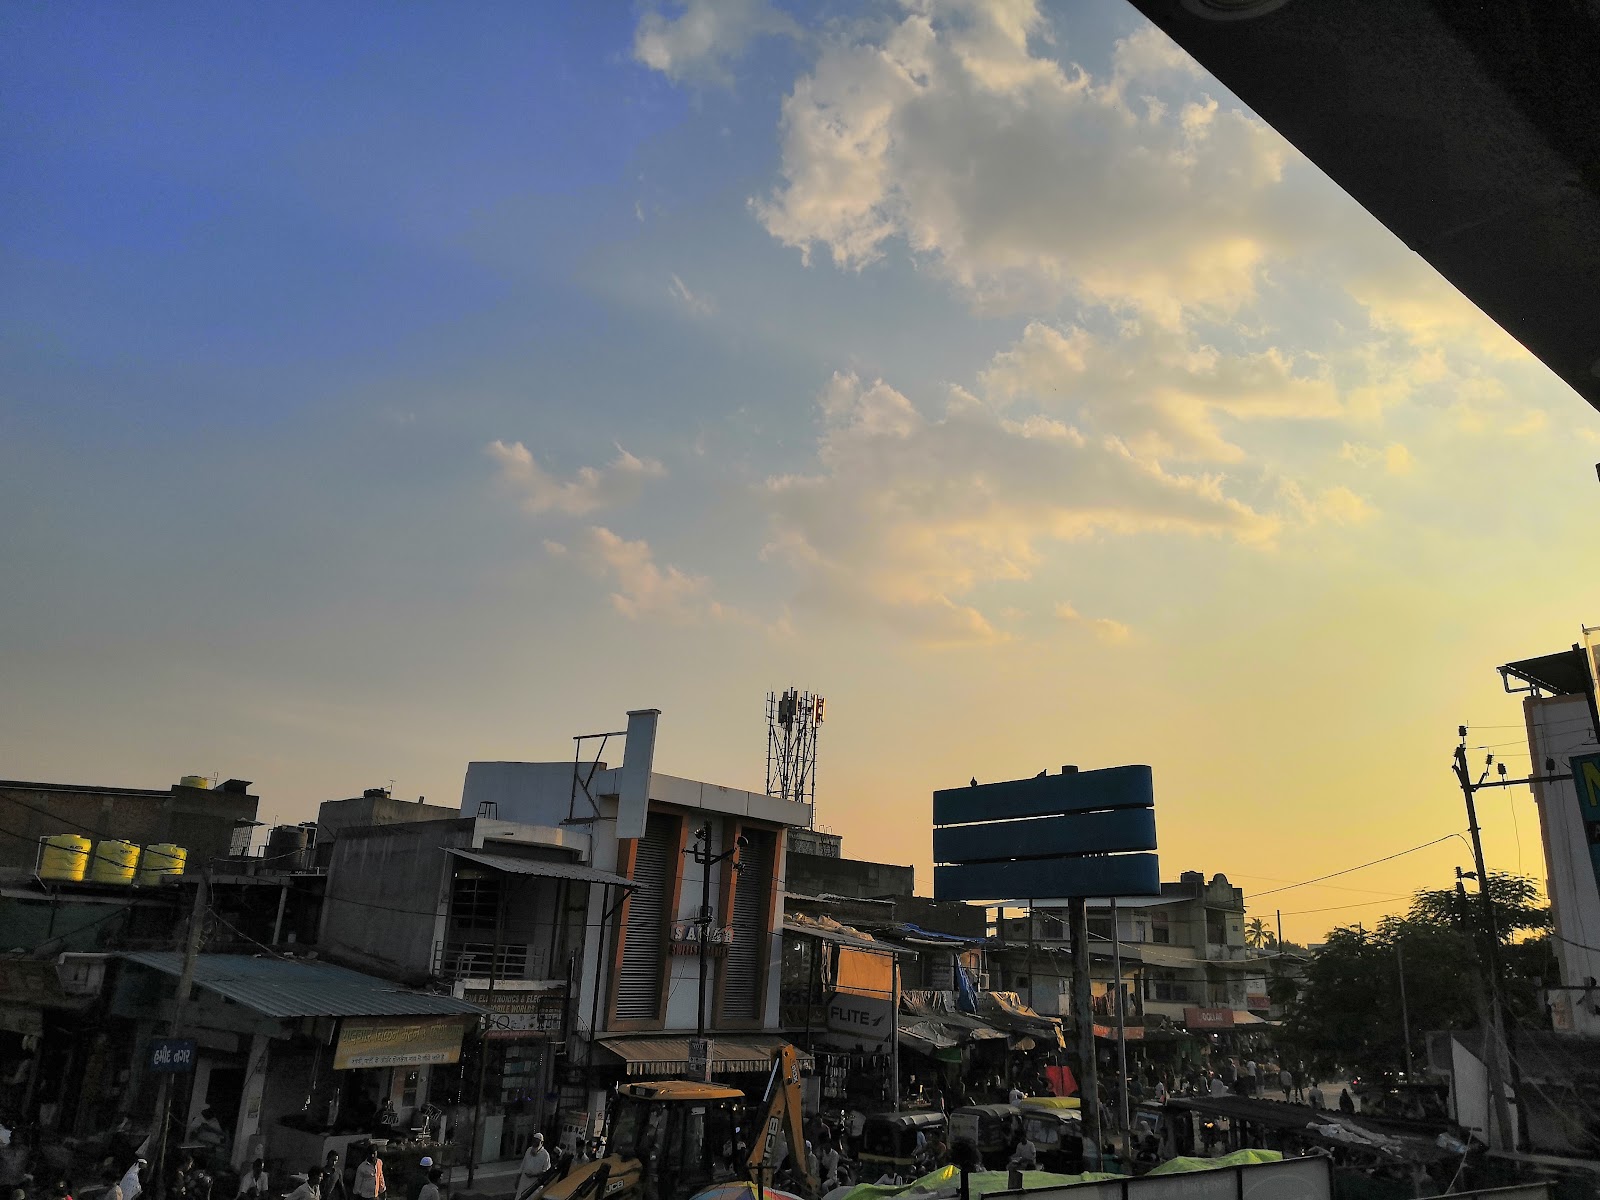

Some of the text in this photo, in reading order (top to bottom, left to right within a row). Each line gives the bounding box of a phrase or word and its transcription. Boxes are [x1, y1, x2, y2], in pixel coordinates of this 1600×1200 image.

[478, 994, 520, 1003] ELTRONICS
[831, 1006, 870, 1025] FLITE
[173, 1050, 191, 1064] નગર
[606, 1180, 625, 1193] JCB
